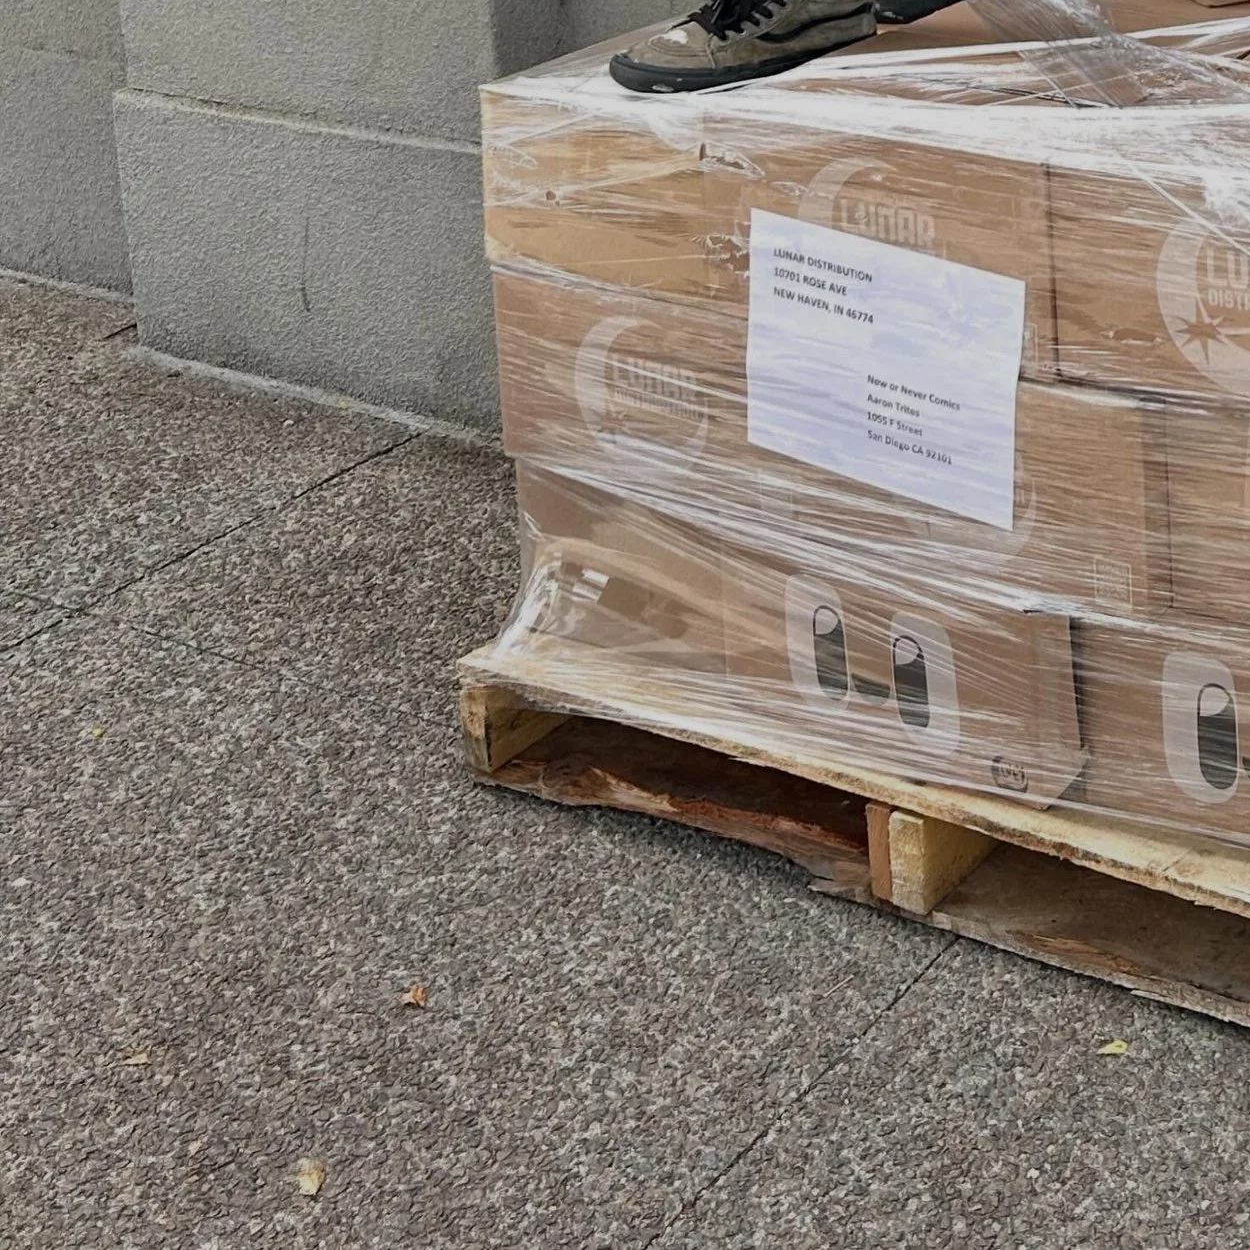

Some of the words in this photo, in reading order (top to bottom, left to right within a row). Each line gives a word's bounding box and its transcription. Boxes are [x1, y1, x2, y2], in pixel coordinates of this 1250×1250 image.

[840, 198, 936, 248] LUNAR
[773, 248, 805, 264] LUNAR
[807, 257, 873, 283] DISTRIBUTION
[774, 267, 800, 283] 10701
[803, 275, 827, 290] ROSE
[828, 282, 848, 296] AVE
[773, 286, 796, 301] NEW
[797, 293, 832, 314] HAVEN,
[833, 304, 844, 316] IN
[846, 308, 875, 324] 46774
[611, 353, 697, 402] LUNAR
[867, 374, 887, 389] Now
[889, 383, 899, 392] or
[900, 384, 927, 401] Never
[929, 393, 961, 411] Comics
[867, 393, 893, 409] Aaron
[895, 401, 920, 418] Trites
[867, 411, 888, 426] 1055
[889, 418, 895, 426] F
[896, 420, 923, 437] Street
[867, 429, 883, 443] San
[885, 435, 910, 452] Diego
[911, 443, 924, 455] CA
[925, 448, 952, 465] 92101
